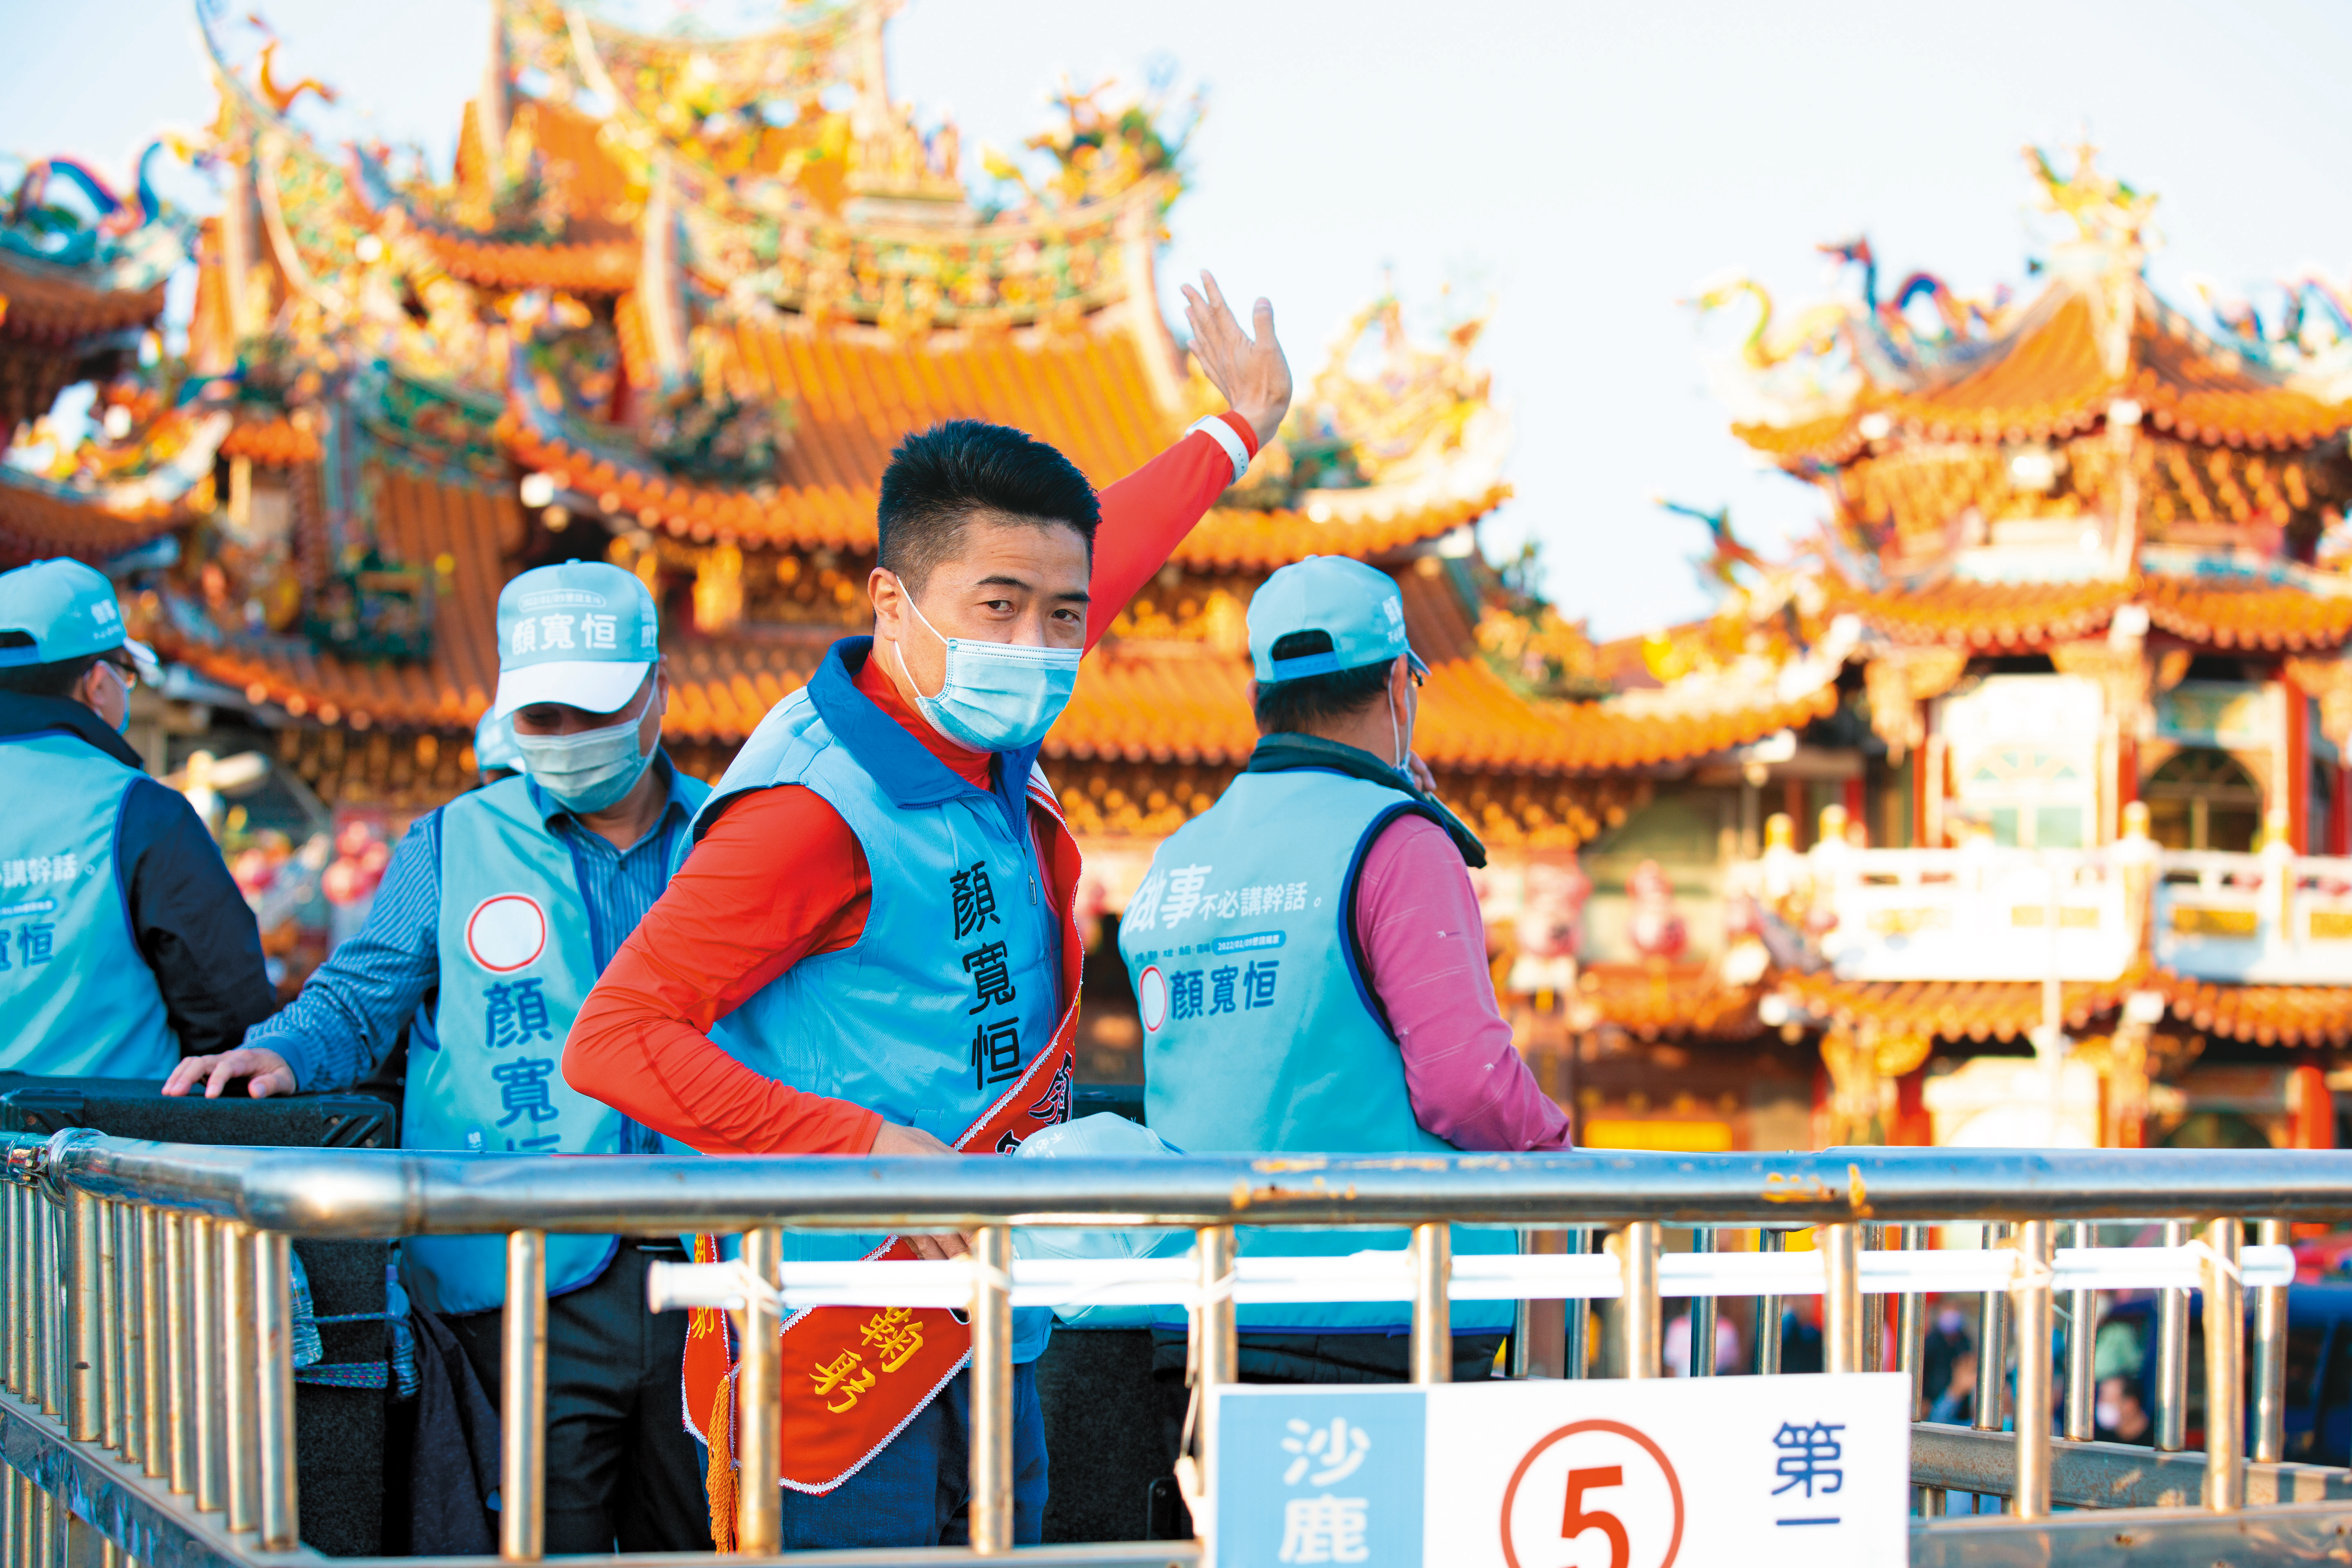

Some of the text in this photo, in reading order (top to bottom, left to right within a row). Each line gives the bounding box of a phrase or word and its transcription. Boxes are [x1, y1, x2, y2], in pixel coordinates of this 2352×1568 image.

[512, 612, 617, 656] 顏寬恒
[0, 853, 96, 889] 講幹話。
[950, 860, 1024, 1091] 顏寬恒
[1169, 960, 1280, 1020] 顏寬恒
[808, 1306, 924, 1414] 鞠躬
[1278, 1416, 1372, 1565] 沙鹿
[1561, 1465, 1630, 1568] 5
